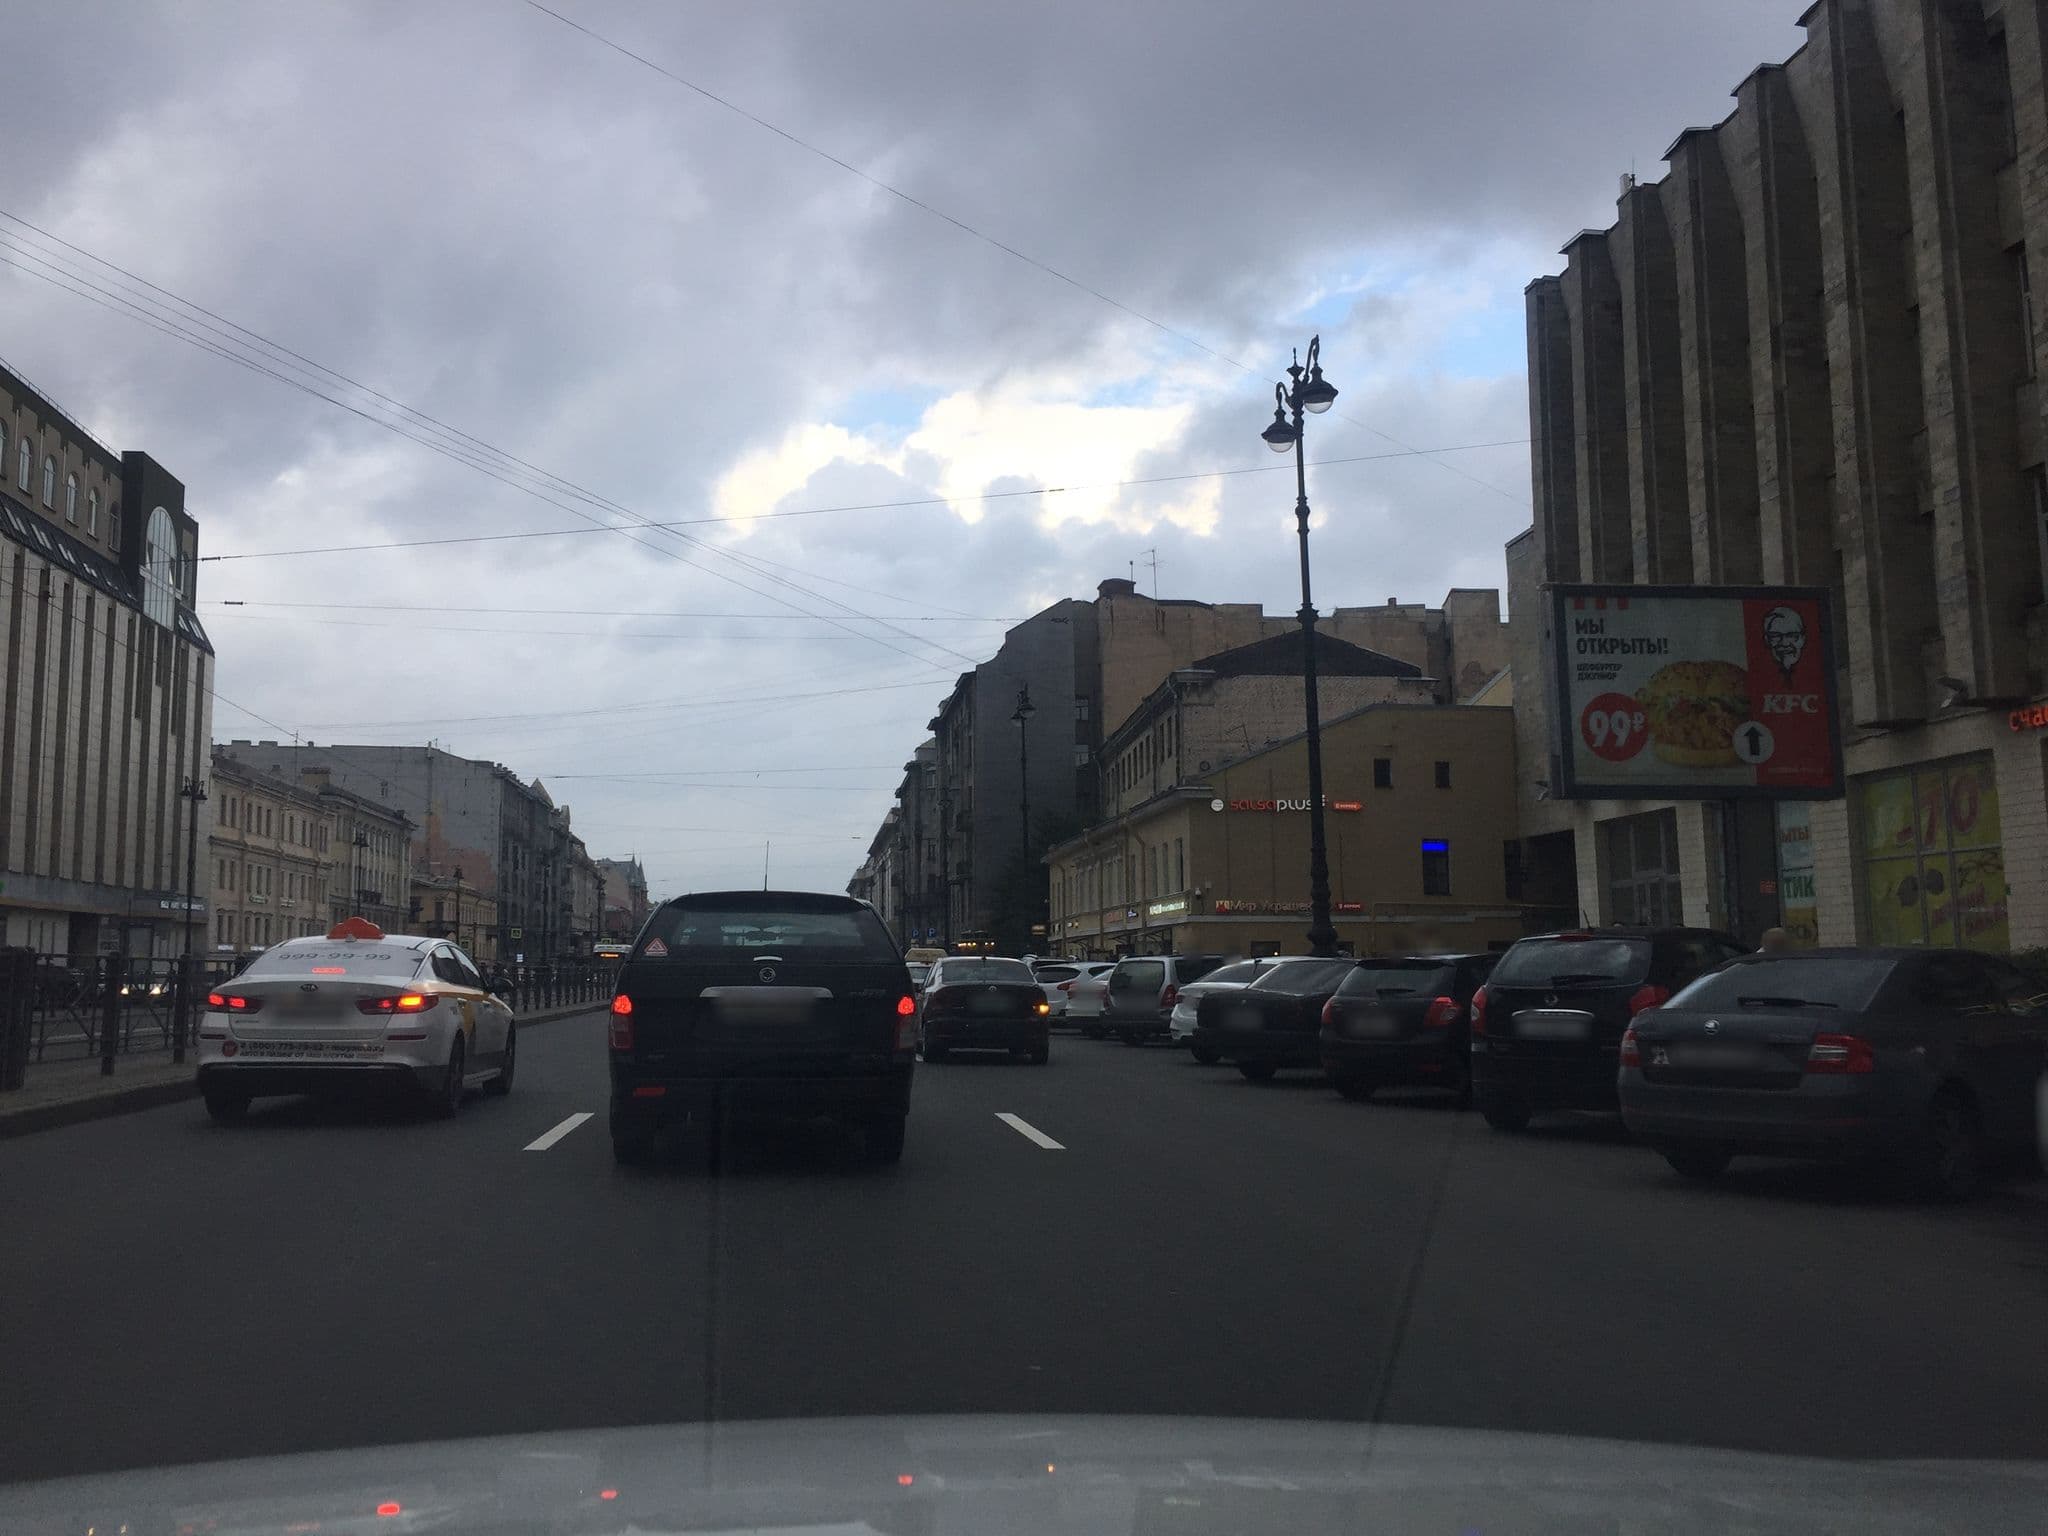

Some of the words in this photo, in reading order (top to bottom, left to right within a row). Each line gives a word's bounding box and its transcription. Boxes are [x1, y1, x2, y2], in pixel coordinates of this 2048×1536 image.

[1575, 618, 1604, 635] МЫ
[1576, 637, 1669, 655] ОТКРЫТЫ!
[1762, 694, 1819, 714] KFC
[1783, 875, 1816, 899] ТИК
